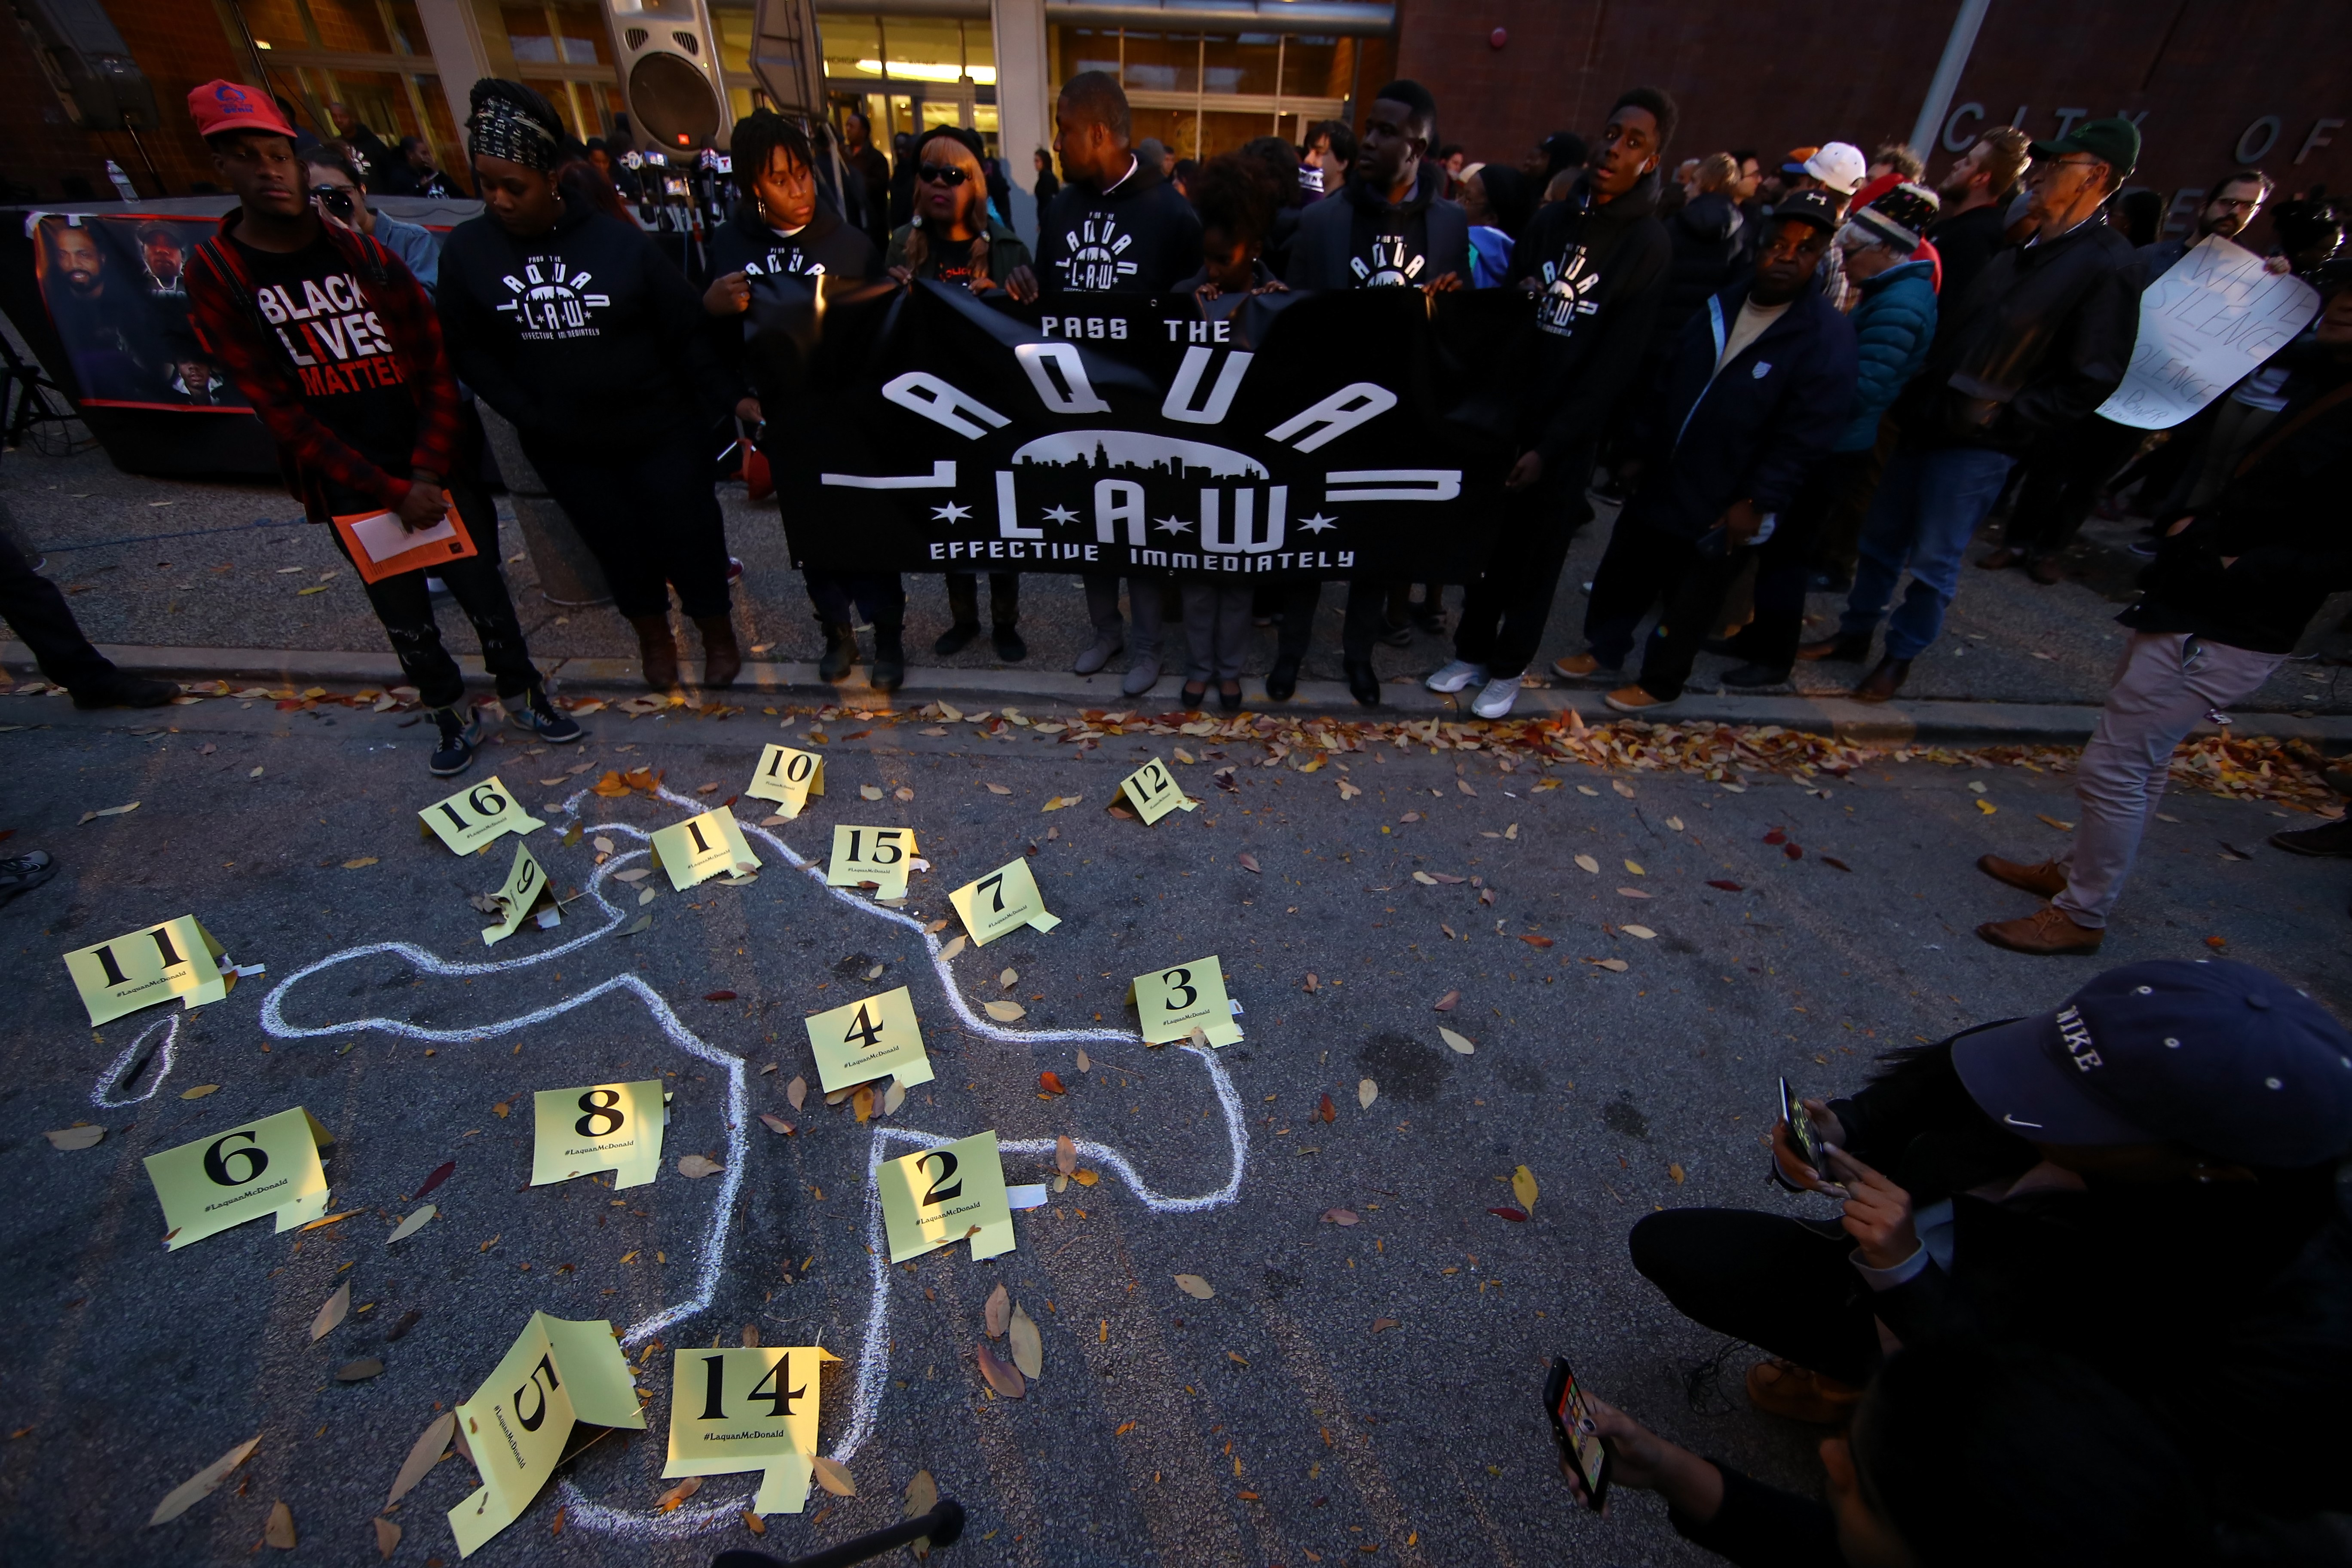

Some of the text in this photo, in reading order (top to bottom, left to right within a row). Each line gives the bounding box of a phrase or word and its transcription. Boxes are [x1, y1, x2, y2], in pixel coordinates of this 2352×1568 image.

[2235, 115, 2345, 165] OF
[1072, 262, 1113, 289] LAW
[2192, 236, 2314, 325] WHITE
[258, 273, 369, 325] BLACK
[524, 300, 585, 330] LAW
[276, 311, 393, 366] LIVES
[1041, 316, 1230, 342] PASS THE
[2141, 279, 2290, 360] SILENCE
[995, 470, 1287, 554] LAW
[930, 541, 1354, 573] EFFECTIVE IMMEDIATELY
[766, 750, 812, 782] 10
[1130, 764, 1169, 804] 12
[437, 784, 507, 833] 16
[686, 821, 713, 854] 1
[845, 830, 903, 864] 15
[517, 859, 535, 894] 9
[688, 848, 731, 870] #LaquanMcDonald
[977, 873, 1005, 913] 7
[988, 904, 1028, 929] #LaquanMcDonald
[90, 927, 188, 989] 11
[116, 971, 187, 998] #LaquanMcDonald
[1162, 968, 1197, 1010] 3
[844, 1002, 884, 1049] 4
[1163, 1009, 1210, 1026] #LaquanMcDonald
[844, 1045, 900, 1069] #LaquanMcDonald
[2056, 1004, 2104, 1072] NIKE
[575, 1090, 624, 1137] 8
[204, 1130, 269, 1187] 6
[564, 1140, 634, 1156] #LaquanMcDonald
[204, 1178, 288, 1213] #LaquanMcDonald
[916, 1151, 962, 1207] 2
[915, 1201, 980, 1226] #LaquanMcDonald
[513, 1352, 560, 1432] 5
[697, 1351, 807, 1420] 14
[703, 1429, 784, 1442] #LaquanMcDonald
